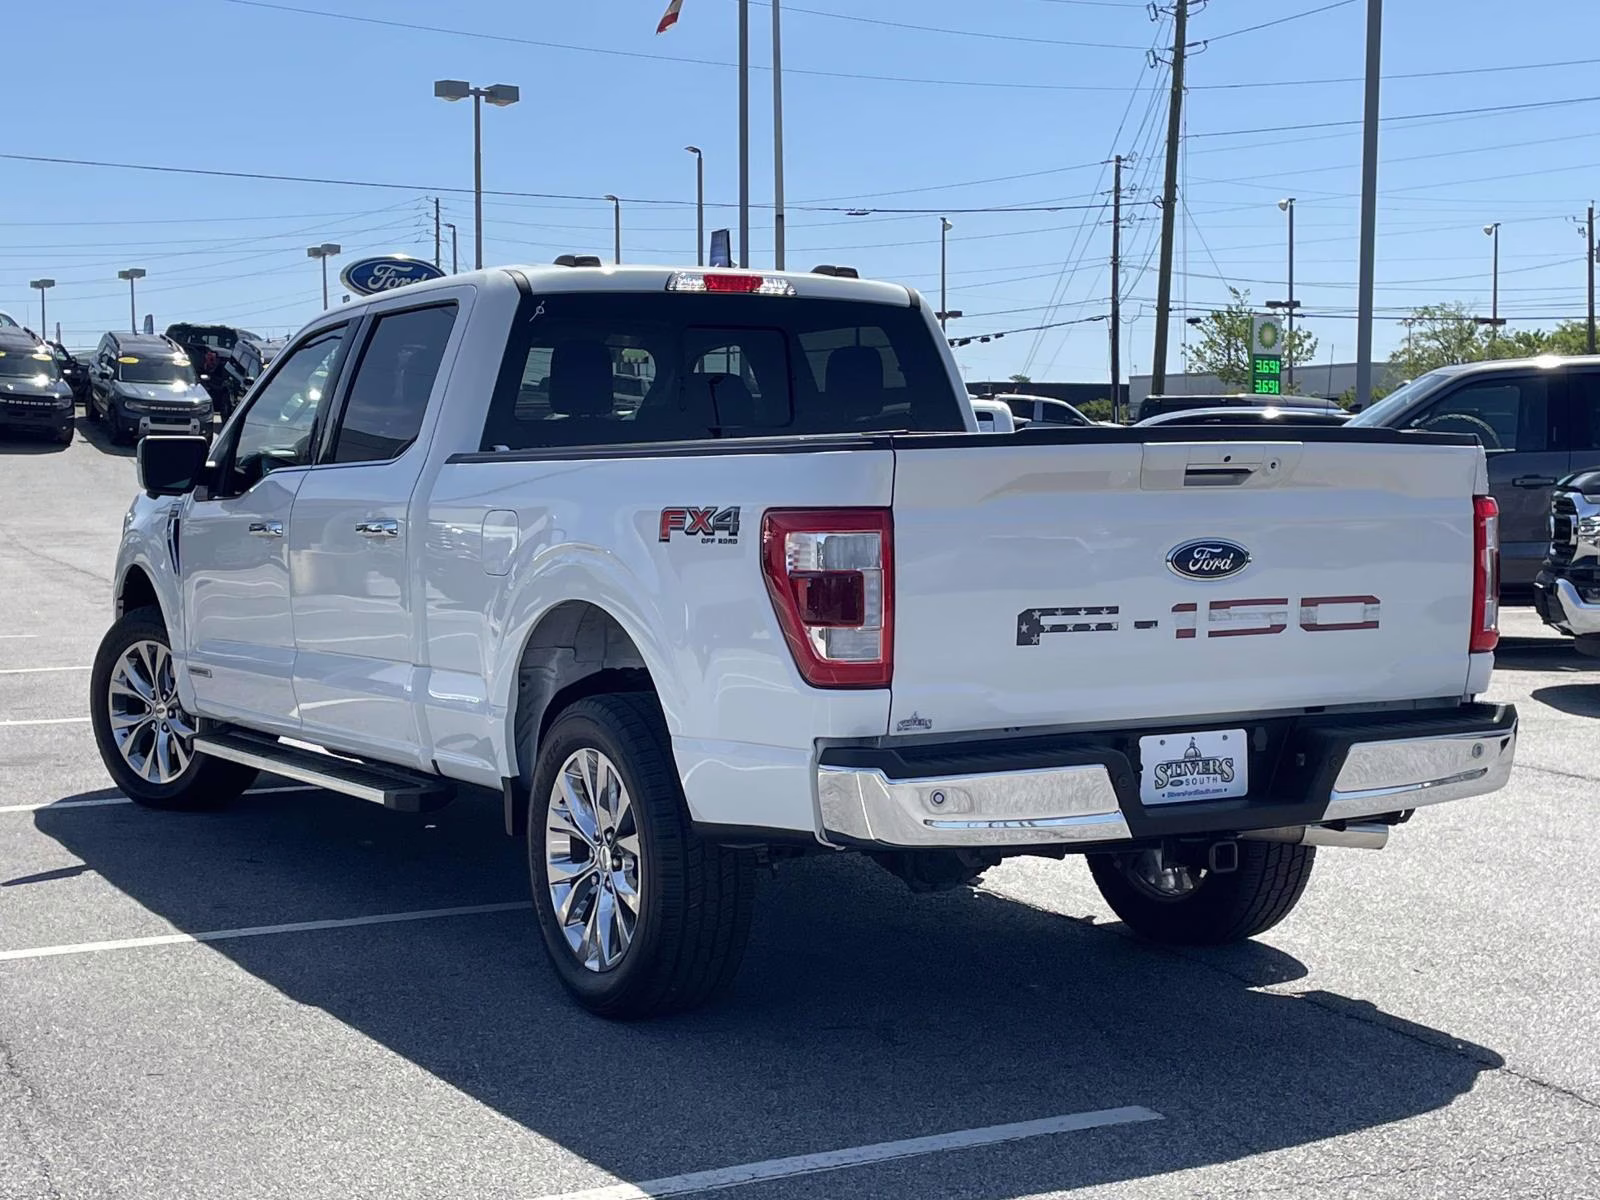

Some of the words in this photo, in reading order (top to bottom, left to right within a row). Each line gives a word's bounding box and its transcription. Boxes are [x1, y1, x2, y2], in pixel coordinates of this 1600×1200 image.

[659, 506, 741, 542] FX4
[1189, 547, 1234, 571] Ford
[1016, 595, 1381, 646] F-150
[1154, 757, 1235, 790] STIVERS
[1185, 776, 1218, 786] SOUTH
